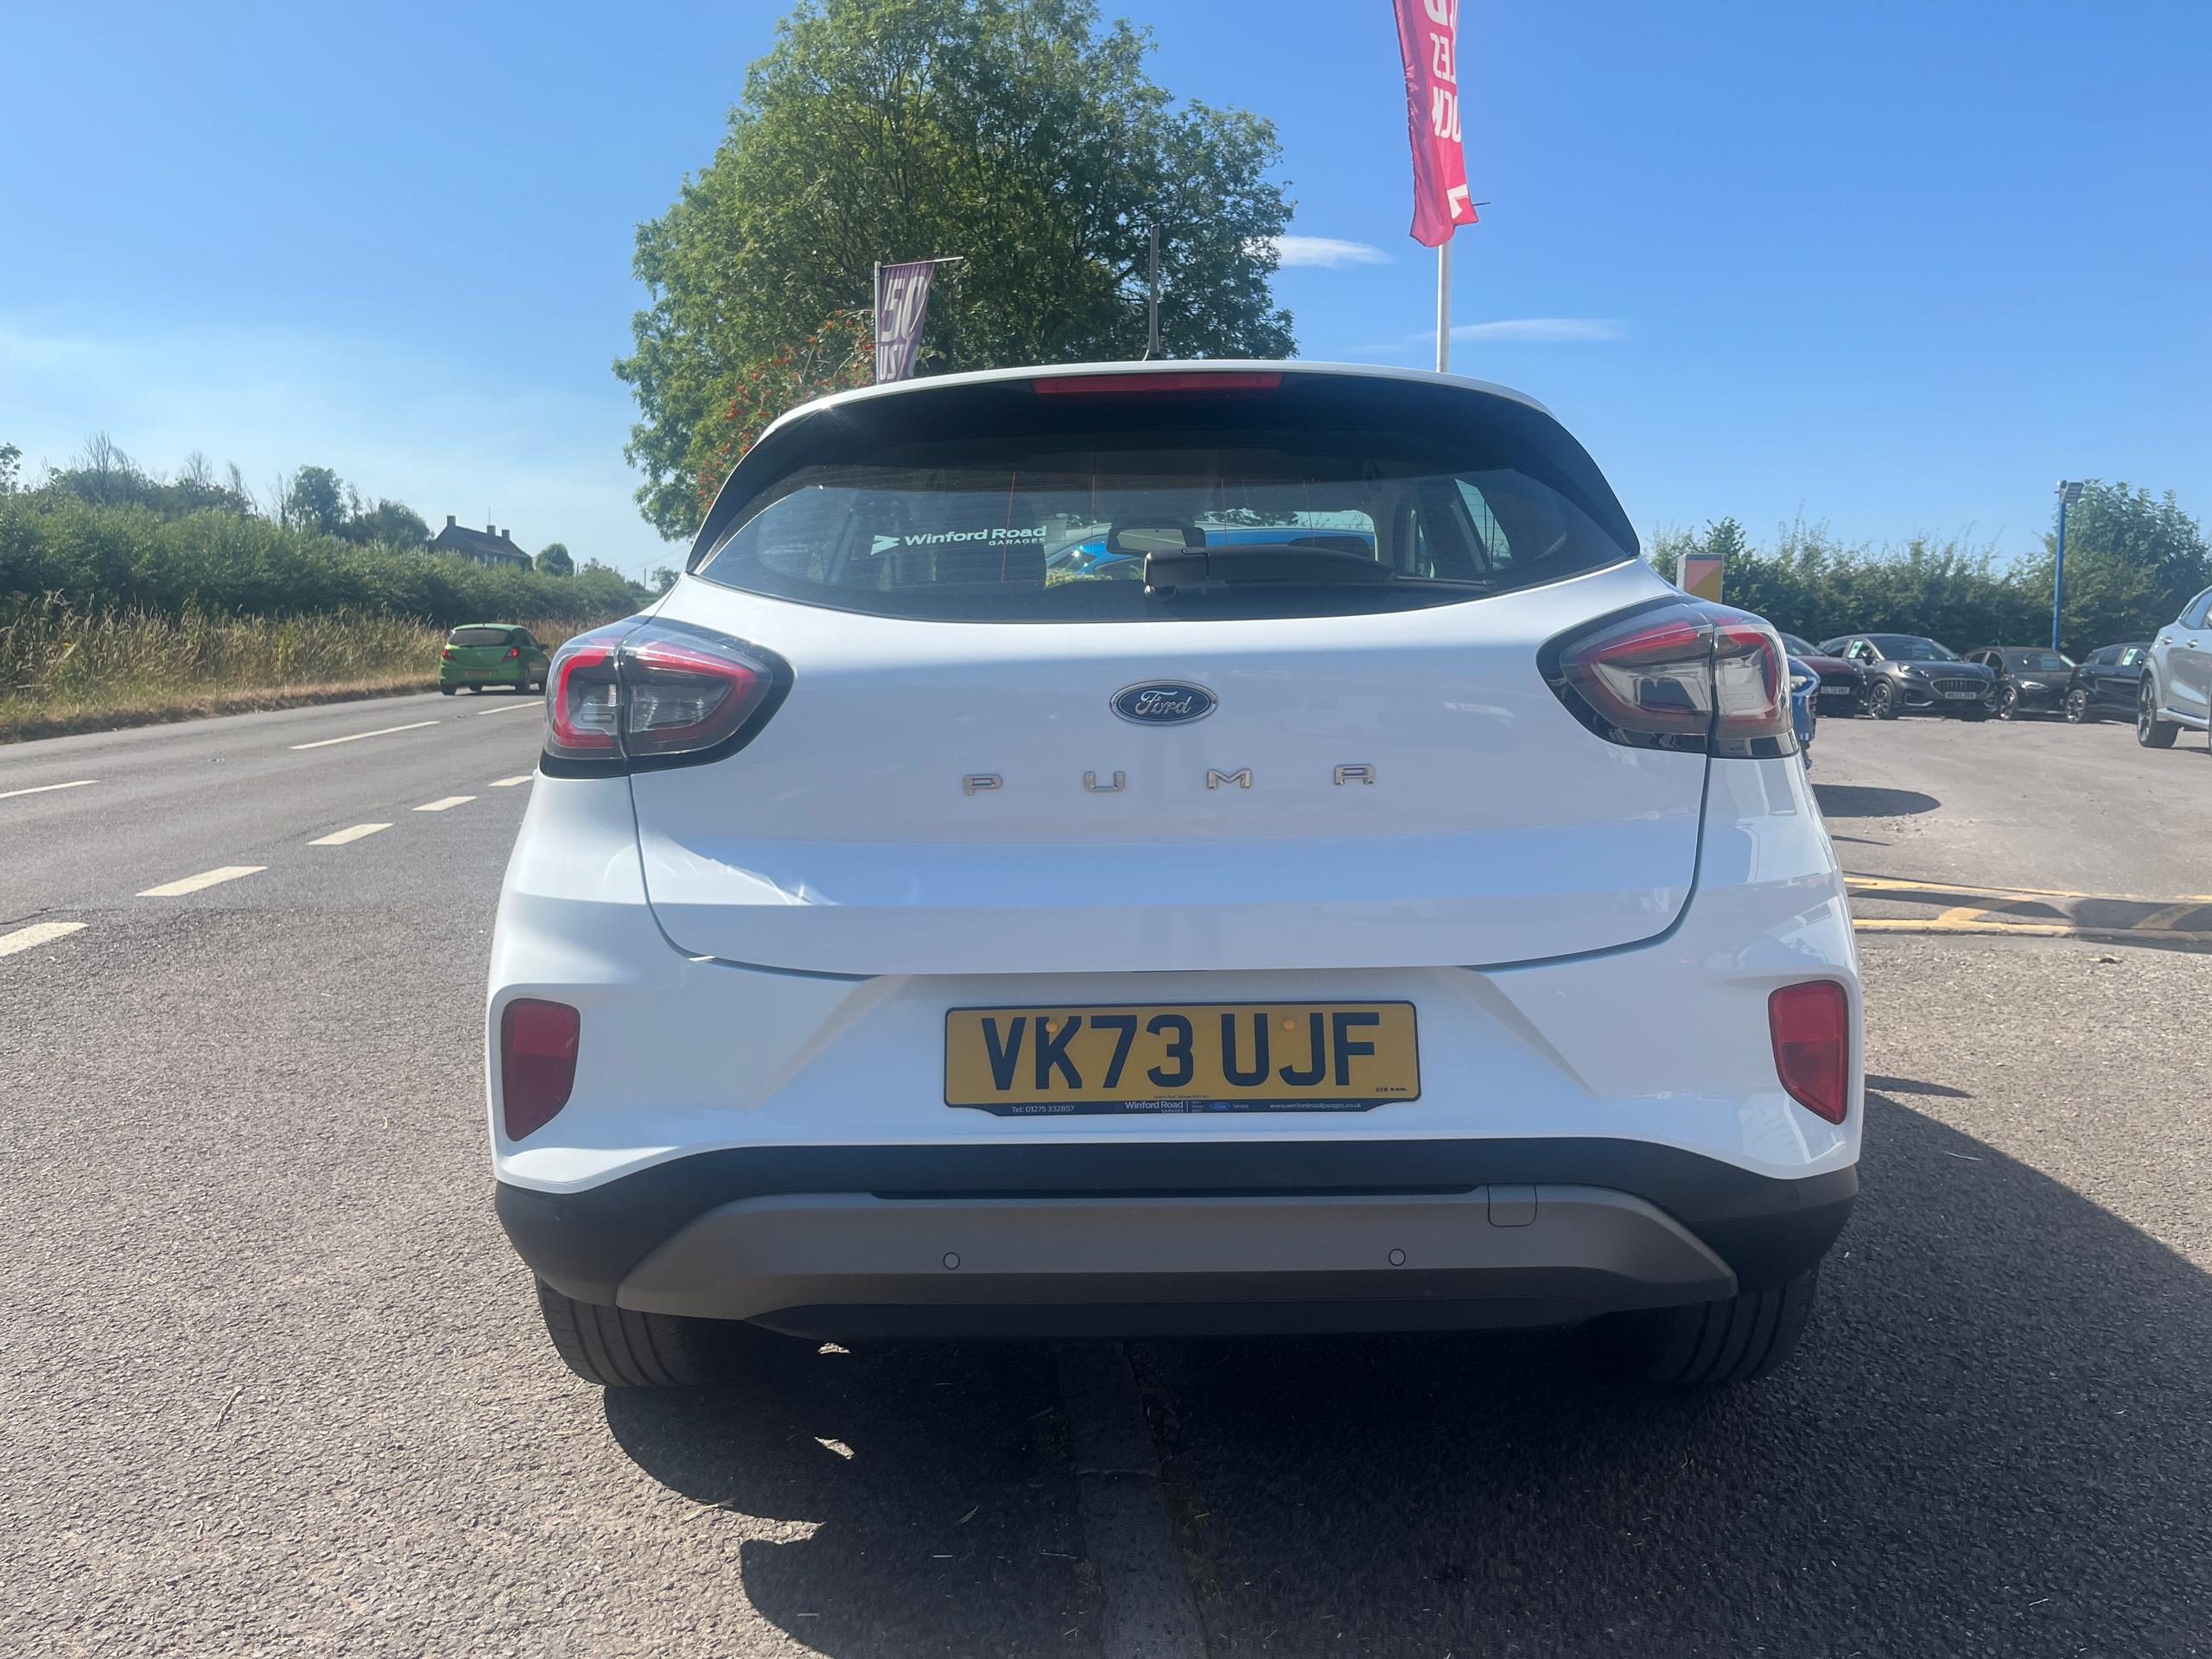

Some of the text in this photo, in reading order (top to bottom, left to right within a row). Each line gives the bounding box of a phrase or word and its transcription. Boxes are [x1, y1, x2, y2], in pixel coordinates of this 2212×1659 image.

[905, 525, 1047, 546] Winford Road
[988, 537, 1046, 547] GARAGES
[1135, 690, 1192, 715] Ford
[963, 764, 1376, 797] PUMA
[981, 1012, 1381, 1091] VK73 UJF
[1125, 1100, 1160, 1109] Winford
[1161, 1100, 1184, 1109] Road
